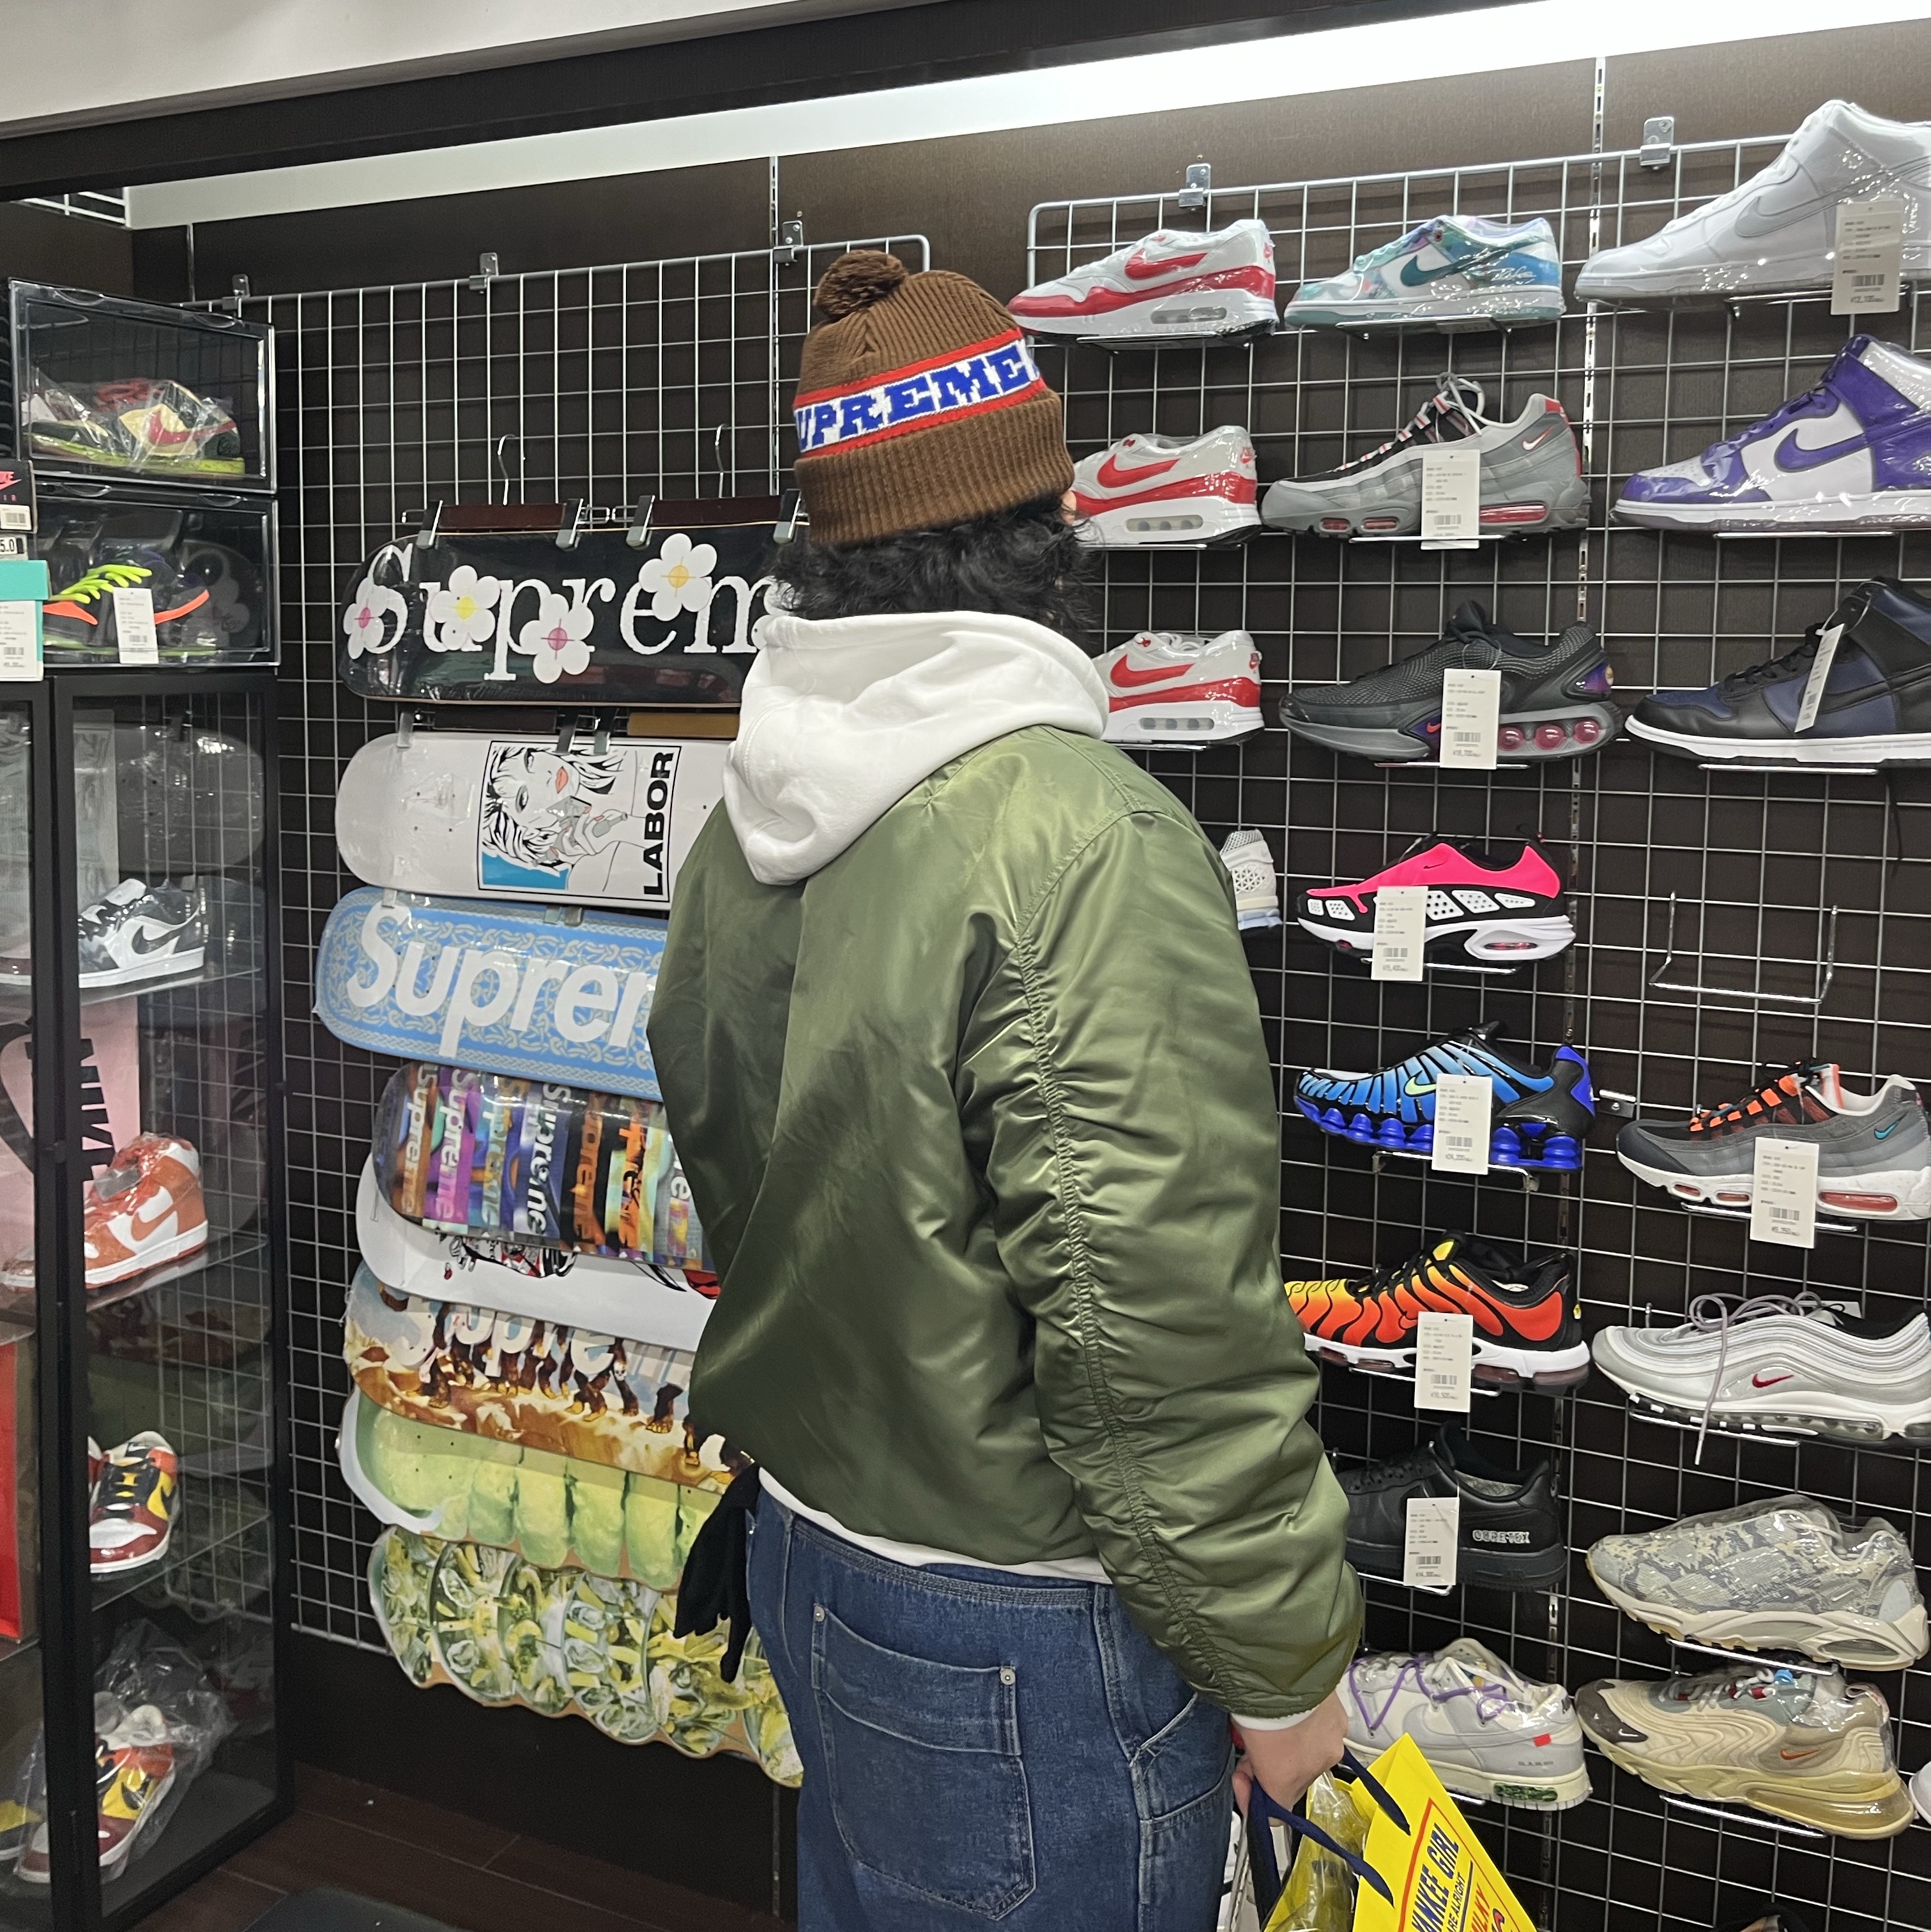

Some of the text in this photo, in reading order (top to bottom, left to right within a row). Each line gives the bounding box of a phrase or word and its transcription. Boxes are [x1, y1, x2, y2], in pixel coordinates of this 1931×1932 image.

[0, 538, 15, 553] 5.0
[643, 752, 675, 895] LABOR
[436, 1069, 480, 1219] Supreme
[526, 1082, 572, 1235] Supreme
[1427, 1822, 1460, 1880] GIRL
[1450, 1871, 1465, 1918] ALRIGHT
[1469, 1882, 1490, 1932] ILKY
